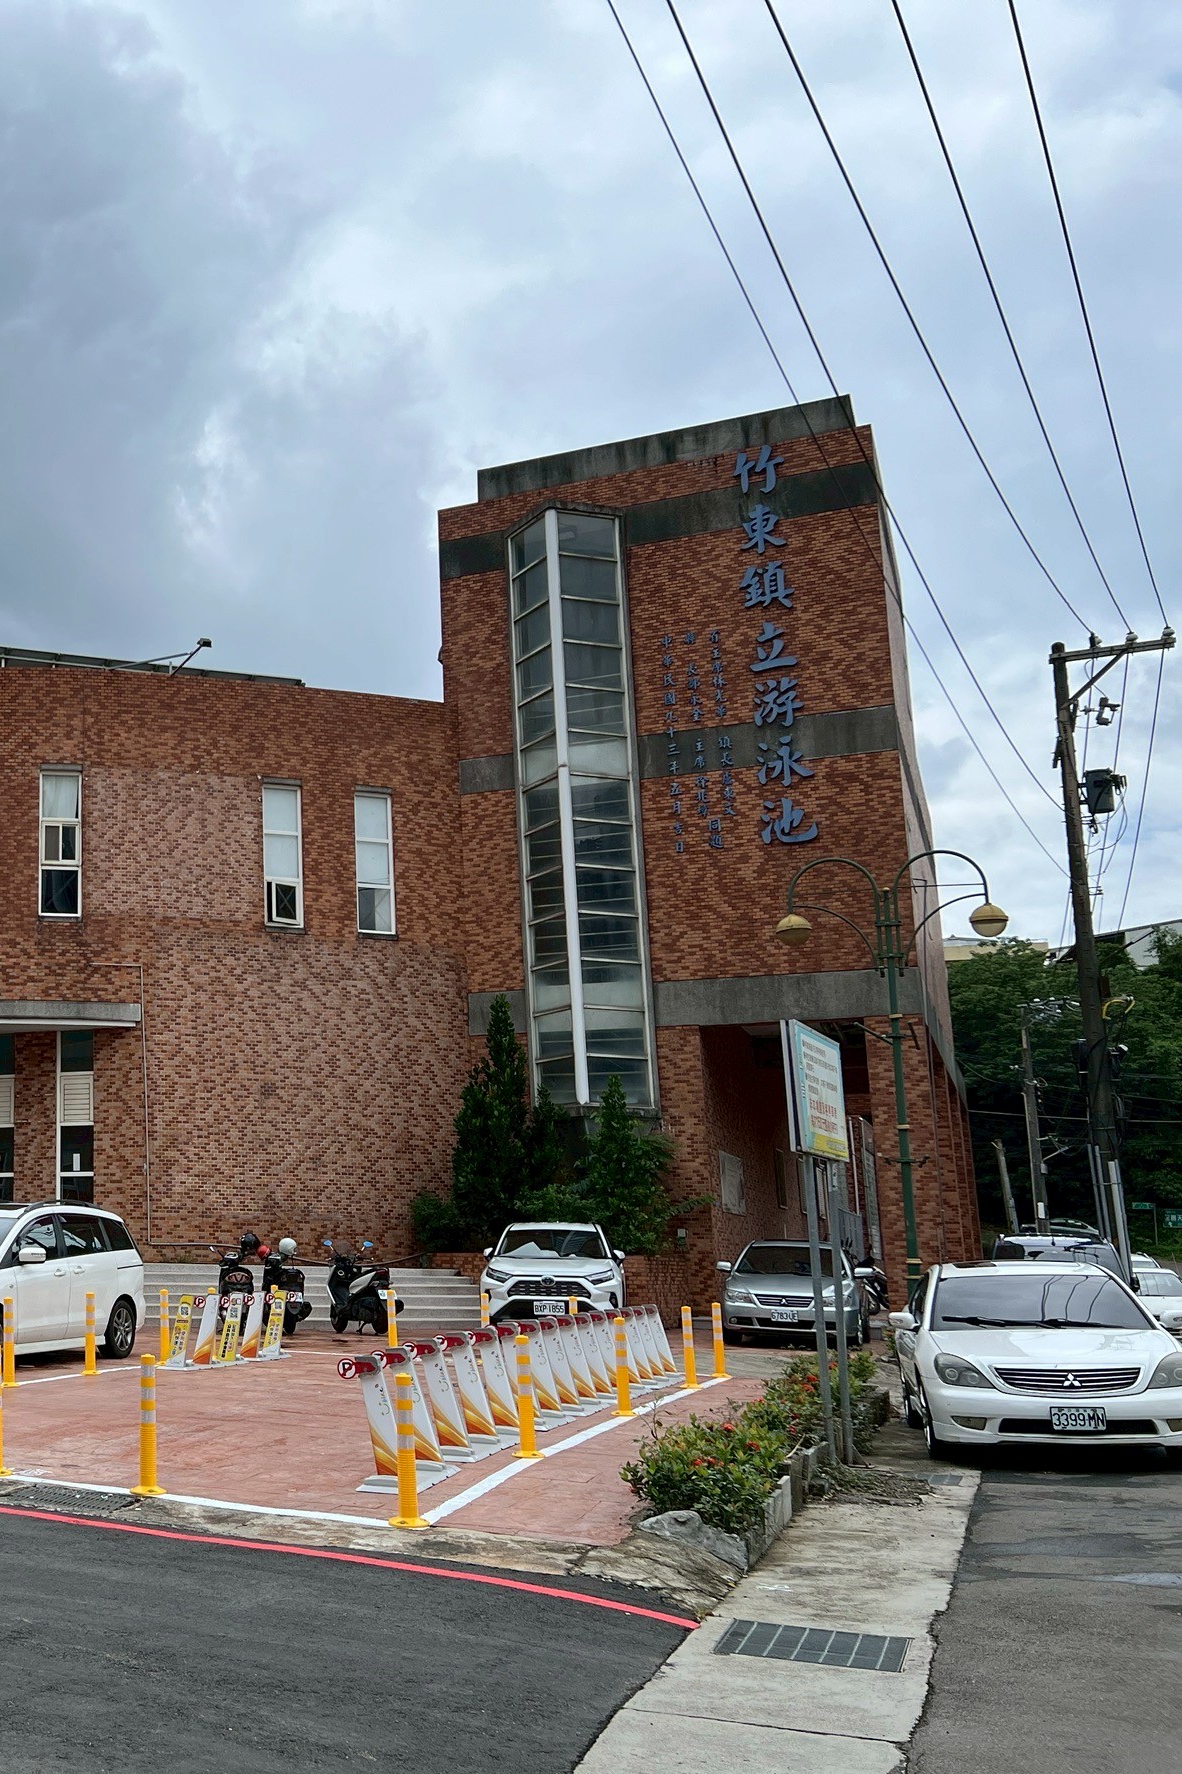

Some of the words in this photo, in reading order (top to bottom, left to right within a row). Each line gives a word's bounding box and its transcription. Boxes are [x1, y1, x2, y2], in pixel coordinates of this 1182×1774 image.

[733, 444, 818, 844] 竹東鎮立游泳池
